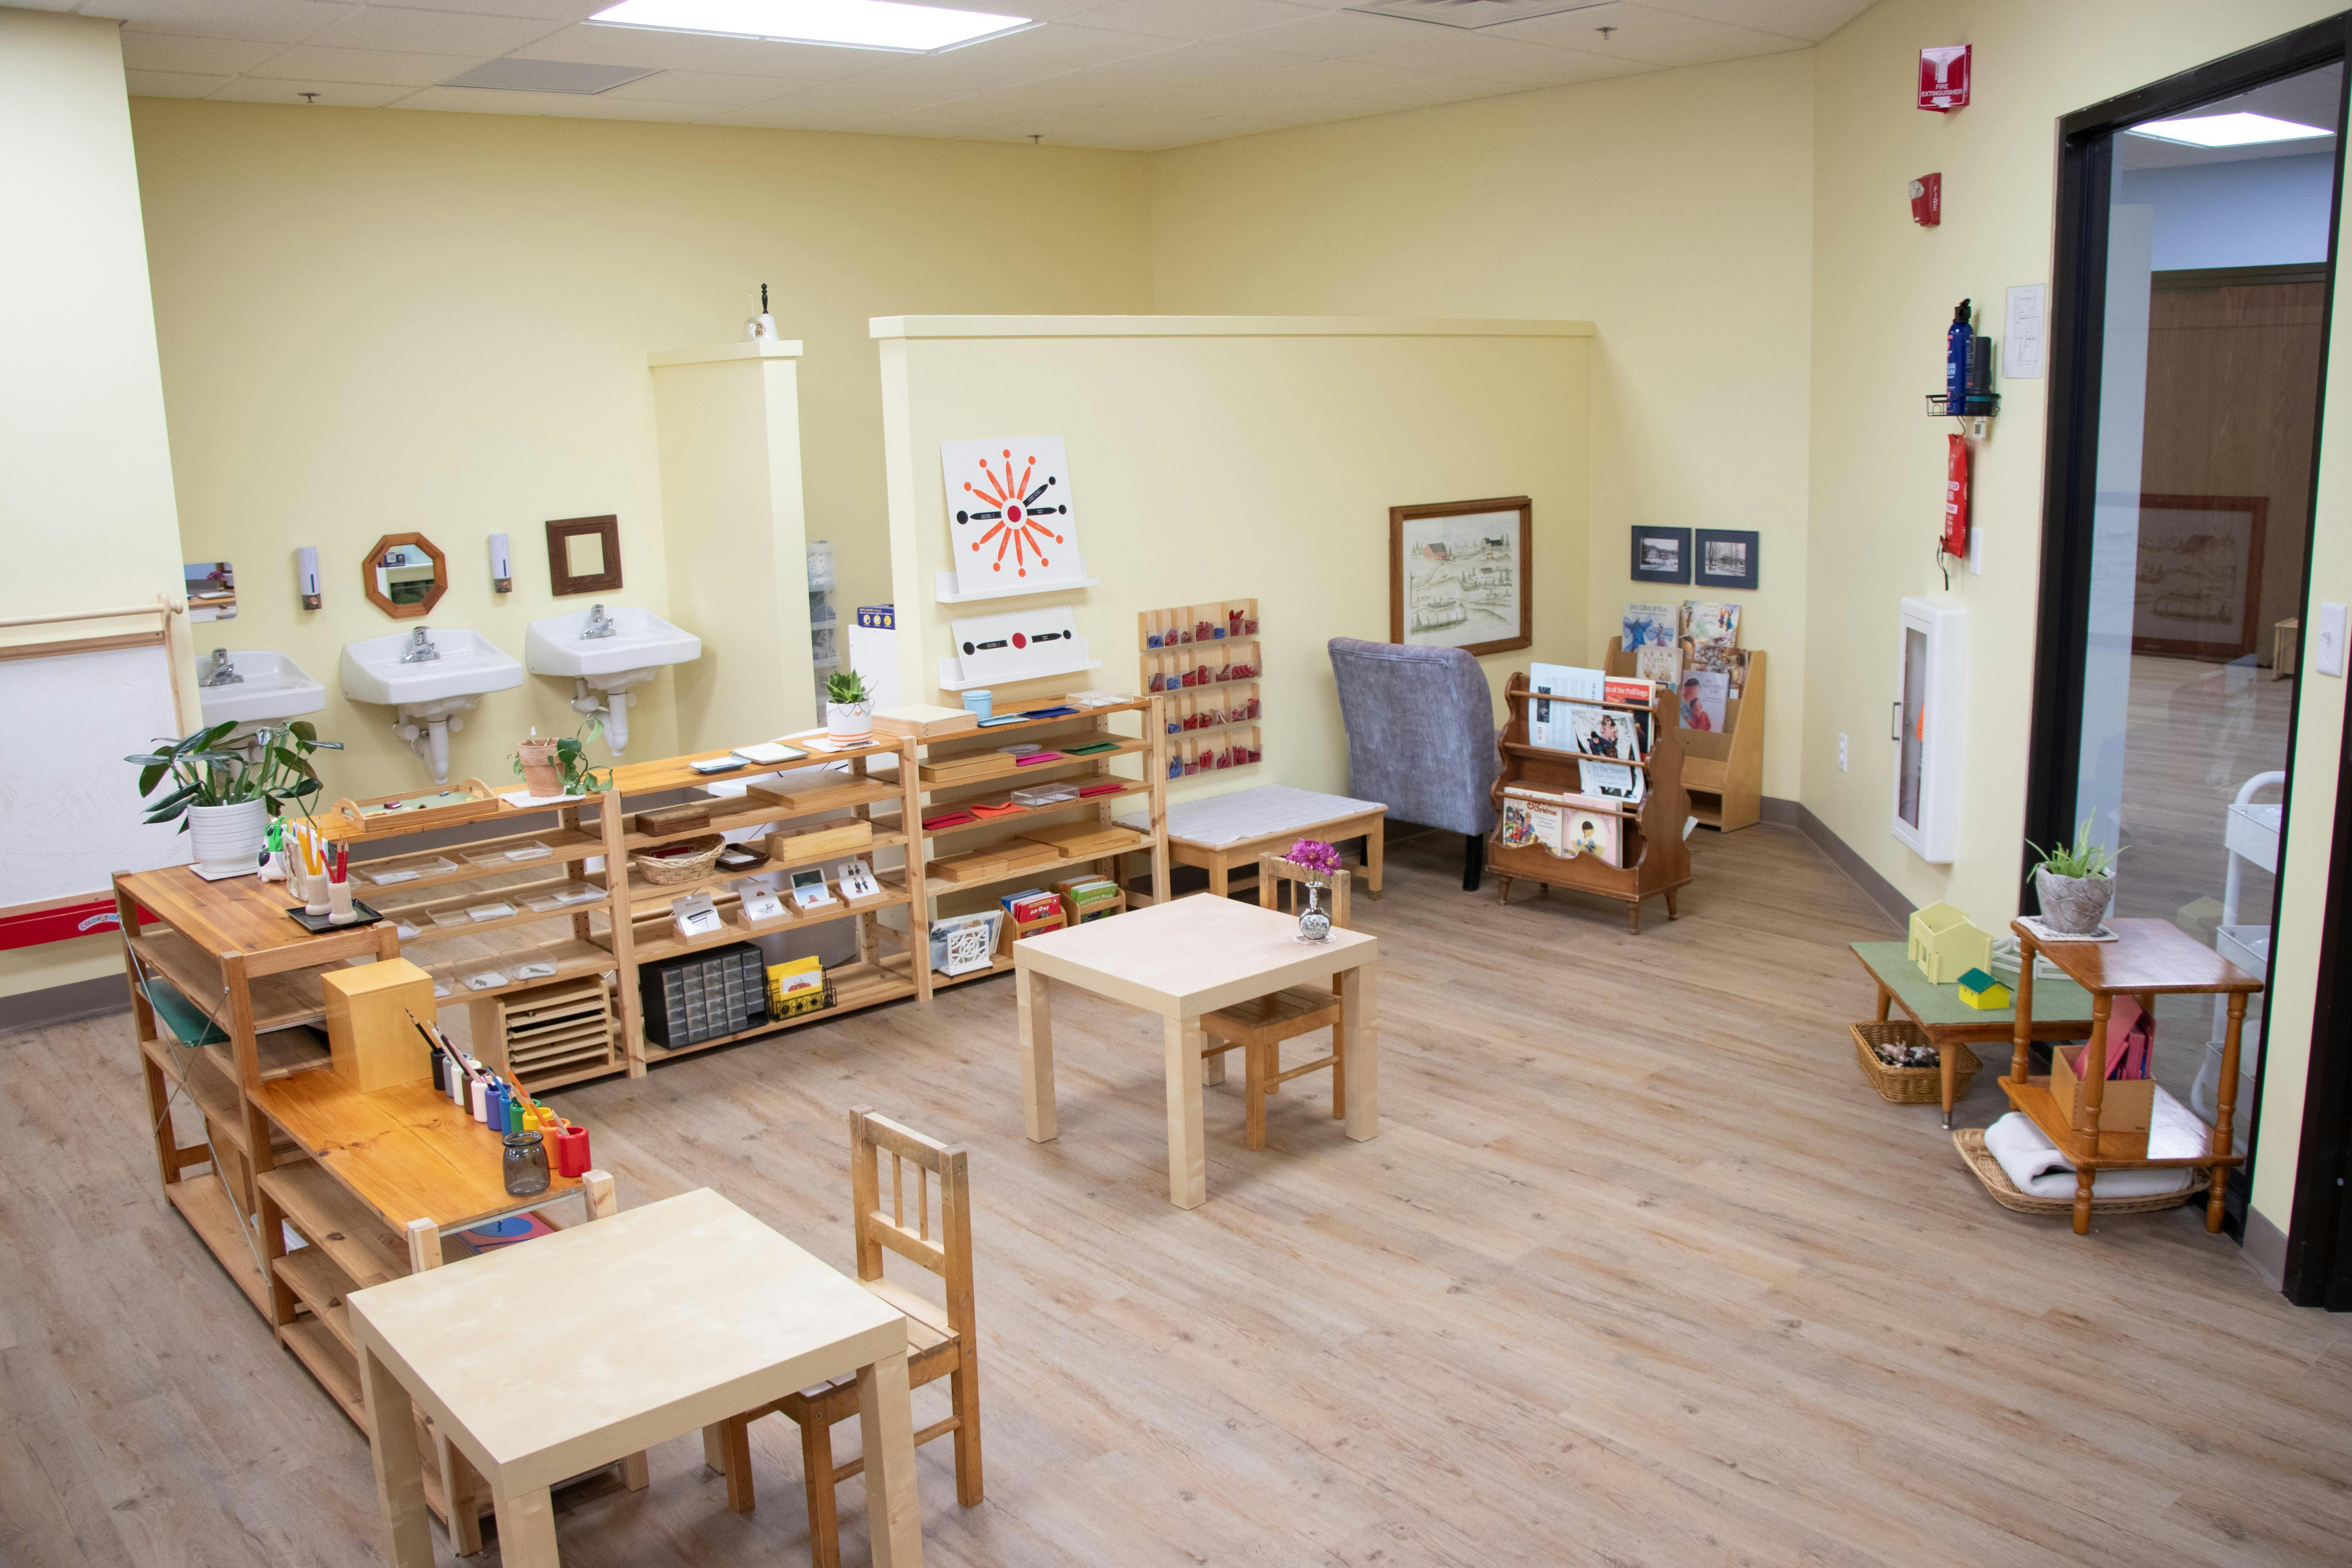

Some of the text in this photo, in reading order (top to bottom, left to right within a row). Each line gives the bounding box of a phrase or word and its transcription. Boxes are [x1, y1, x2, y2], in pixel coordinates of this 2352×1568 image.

[1626, 688, 1648, 697] Pufflings
[1534, 805, 1557, 815] Christmas
[1080, 896, 1100, 904] Welcome
